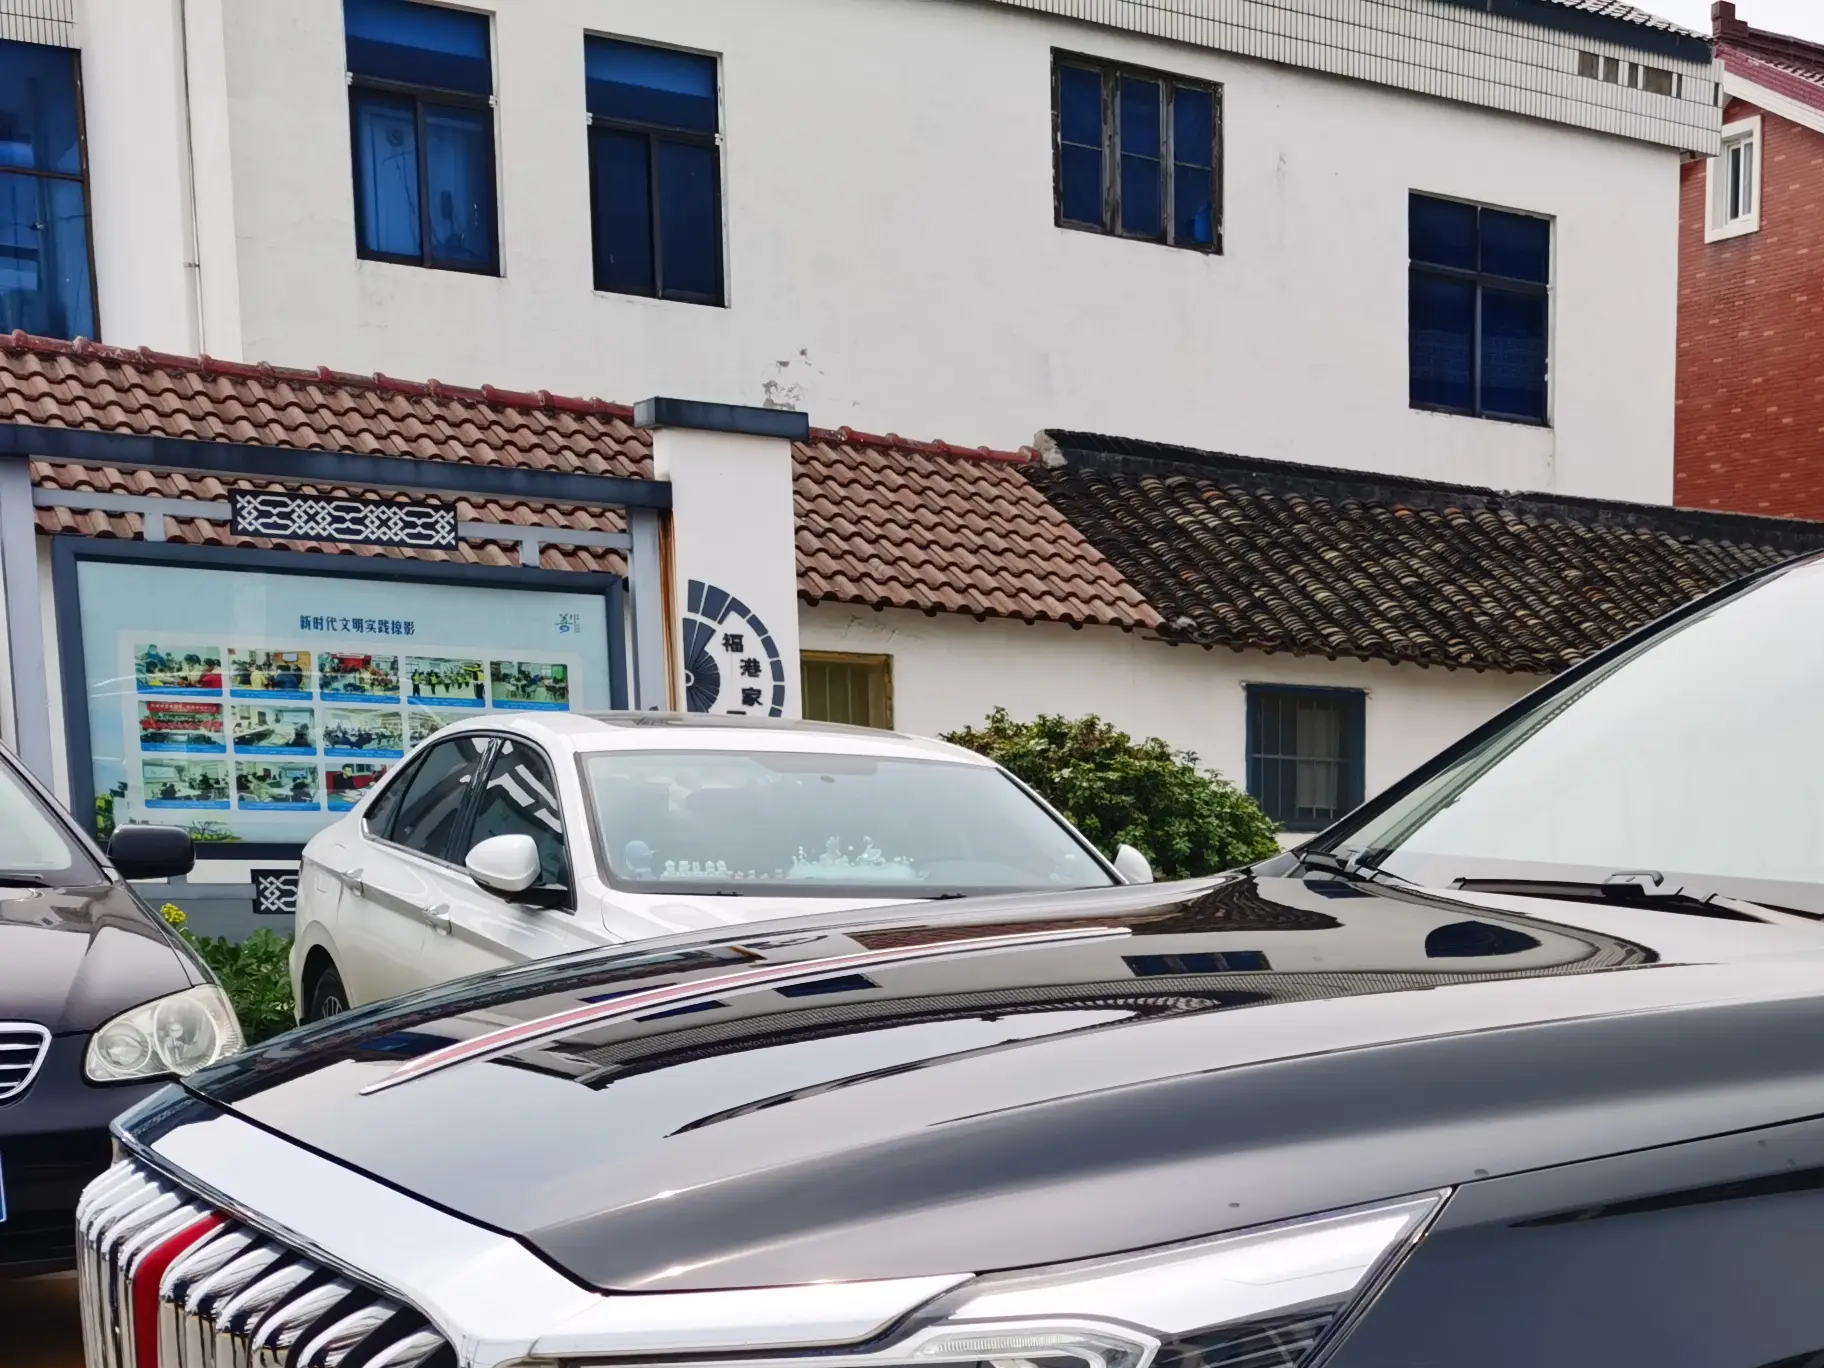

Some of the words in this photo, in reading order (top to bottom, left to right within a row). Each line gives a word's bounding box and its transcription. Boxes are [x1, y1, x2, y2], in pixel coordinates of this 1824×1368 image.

[299, 614, 416, 636] 新时代文明实践掠影
[721, 632, 763, 715] 福港家
